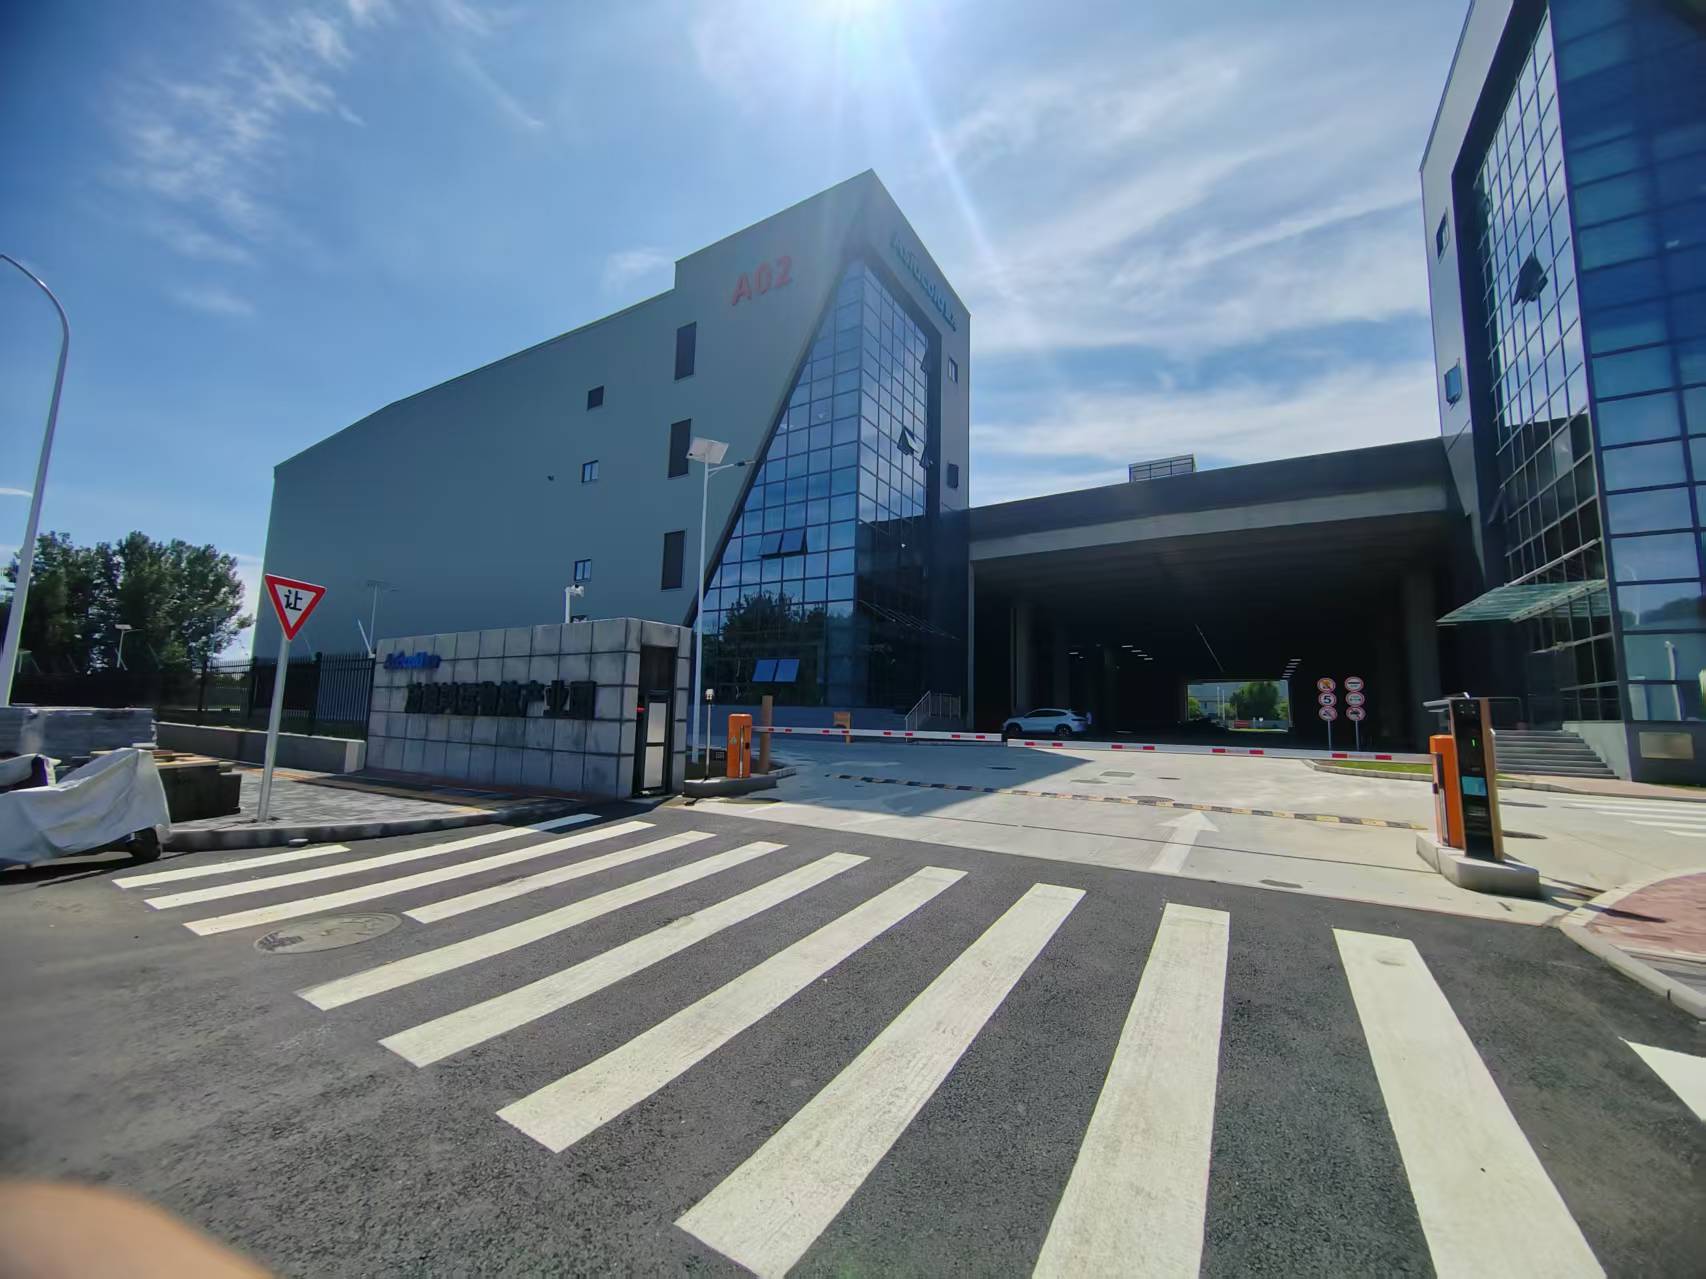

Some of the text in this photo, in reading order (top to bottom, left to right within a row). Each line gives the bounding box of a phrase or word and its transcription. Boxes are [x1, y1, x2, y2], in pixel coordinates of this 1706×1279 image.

[731, 255, 793, 306] A02
[284, 589, 303, 612] 让
[1323, 695, 1332, 705] 5
